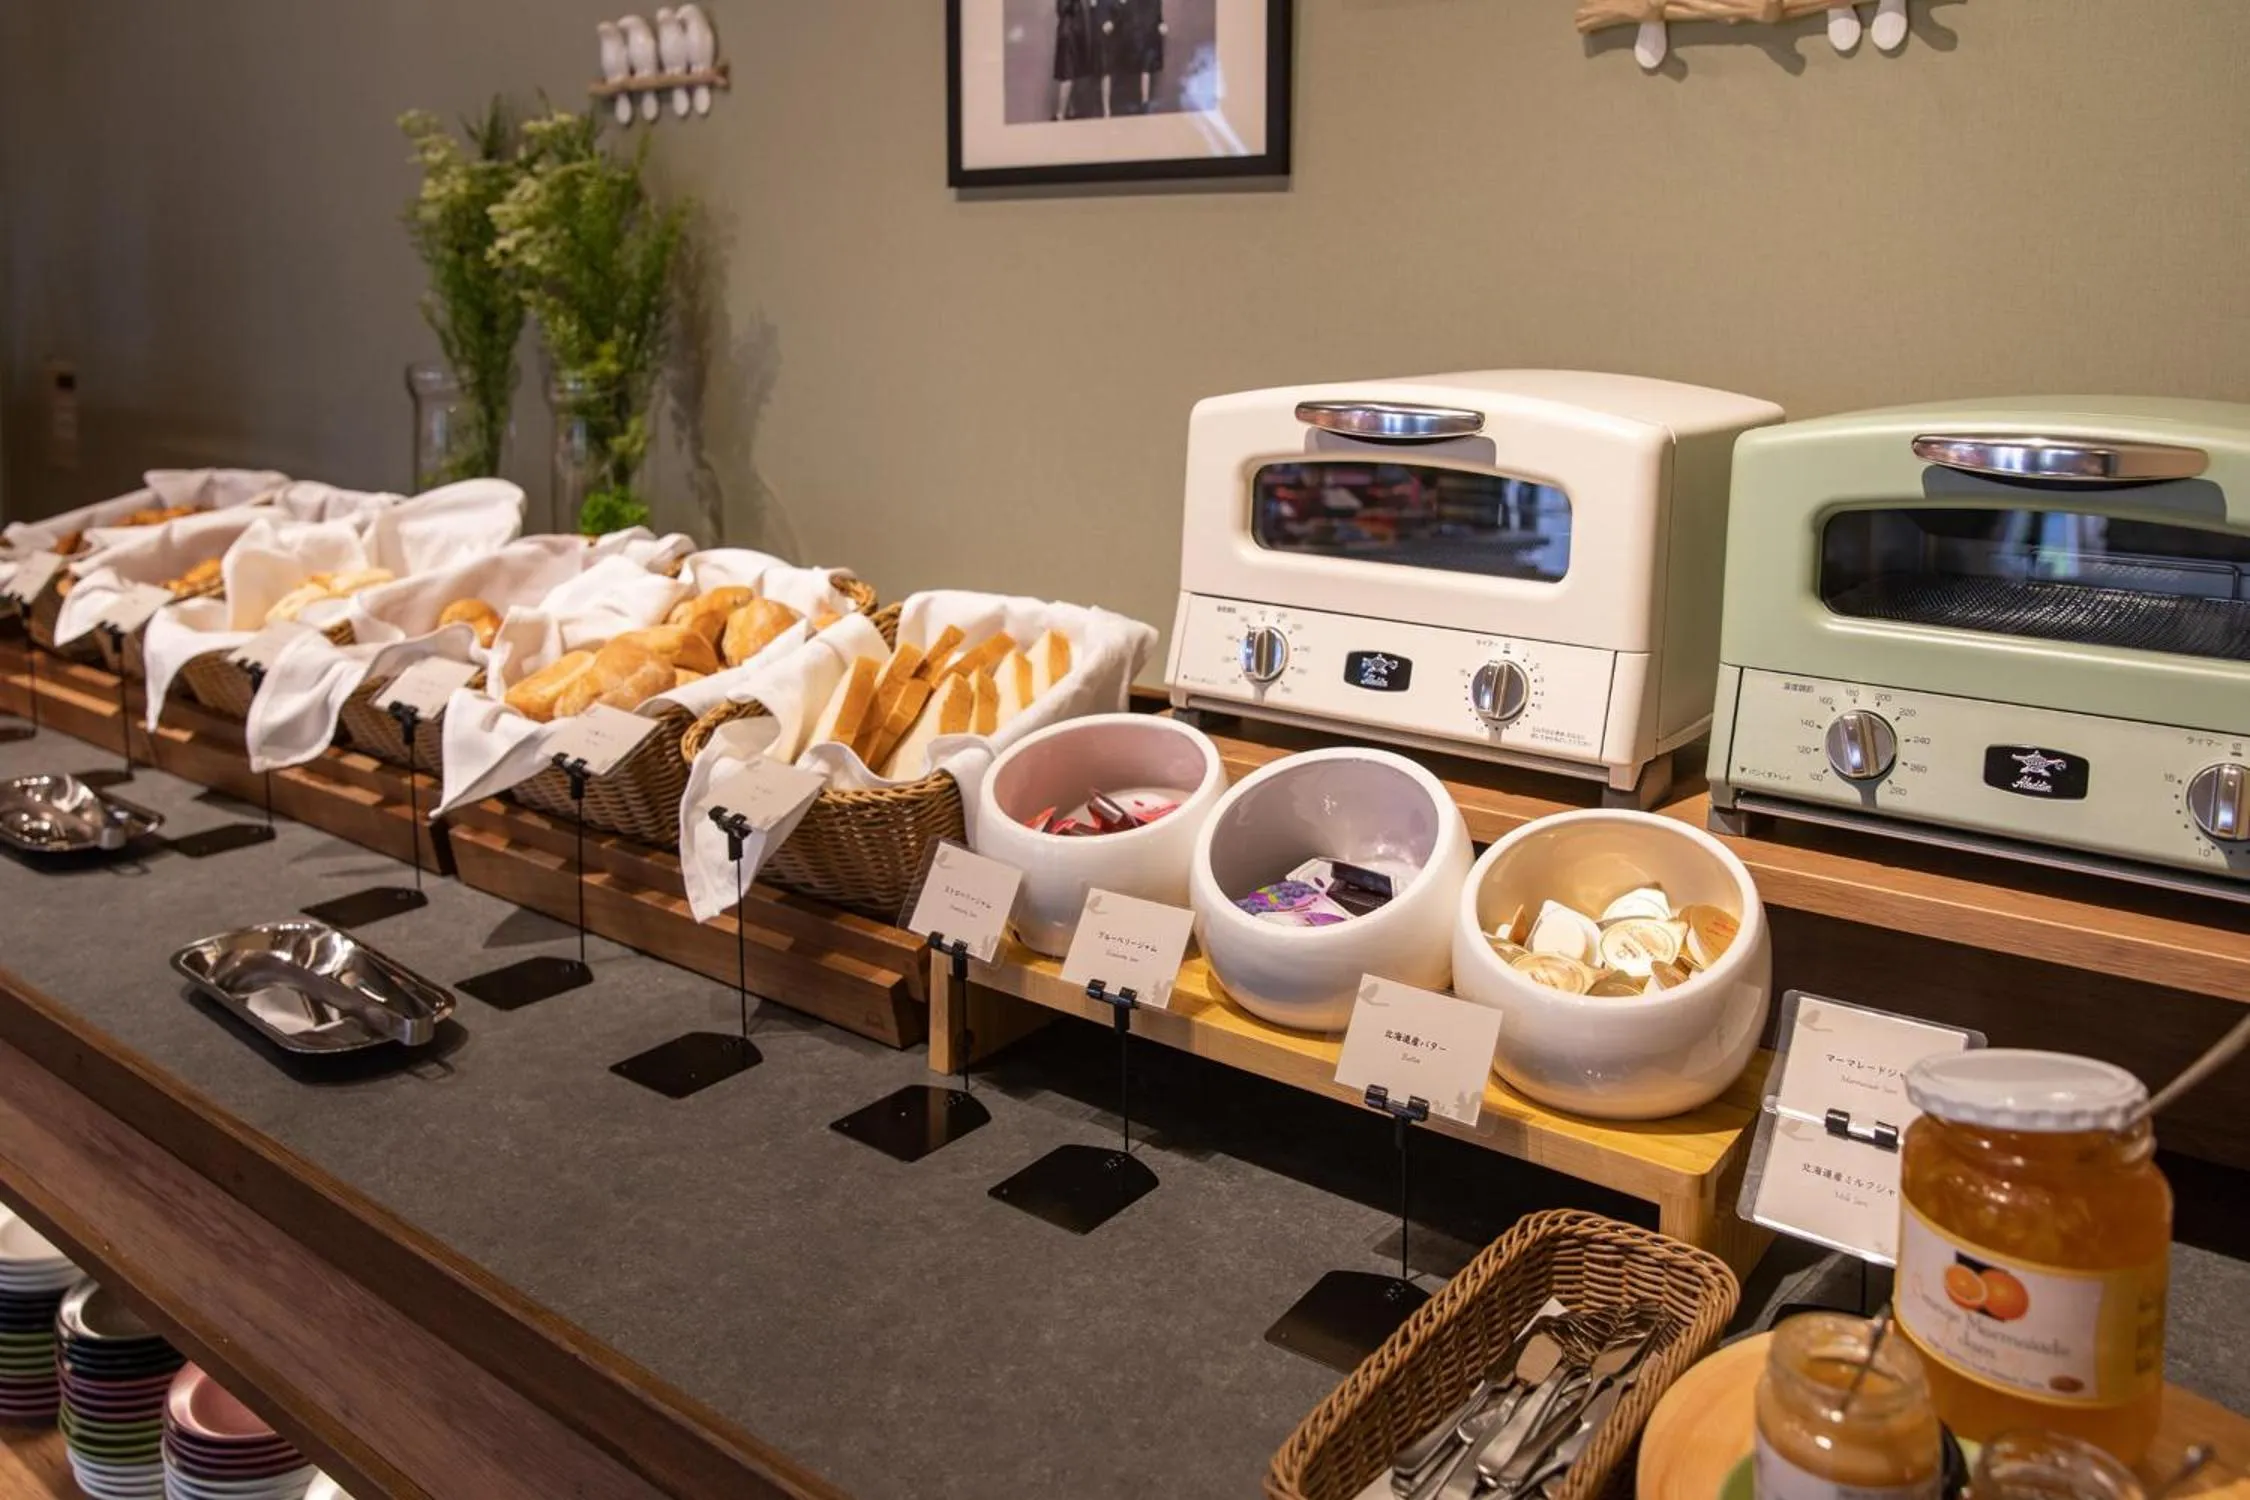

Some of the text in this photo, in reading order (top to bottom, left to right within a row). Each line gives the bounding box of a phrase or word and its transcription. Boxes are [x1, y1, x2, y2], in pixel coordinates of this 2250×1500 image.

[1875, 693, 1892, 702] 200
[1899, 708, 1916, 717] 220
[1800, 719, 1815, 728] 140
[1913, 736, 1931, 745] 240
[2198, 848, 2211, 857] 10
[1384, 1030, 1447, 1051] 北海道産バター
[1826, 1054, 1904, 1080] マーマレードジャ
[1801, 1162, 1896, 1197] 北海道産ミルクジャ
